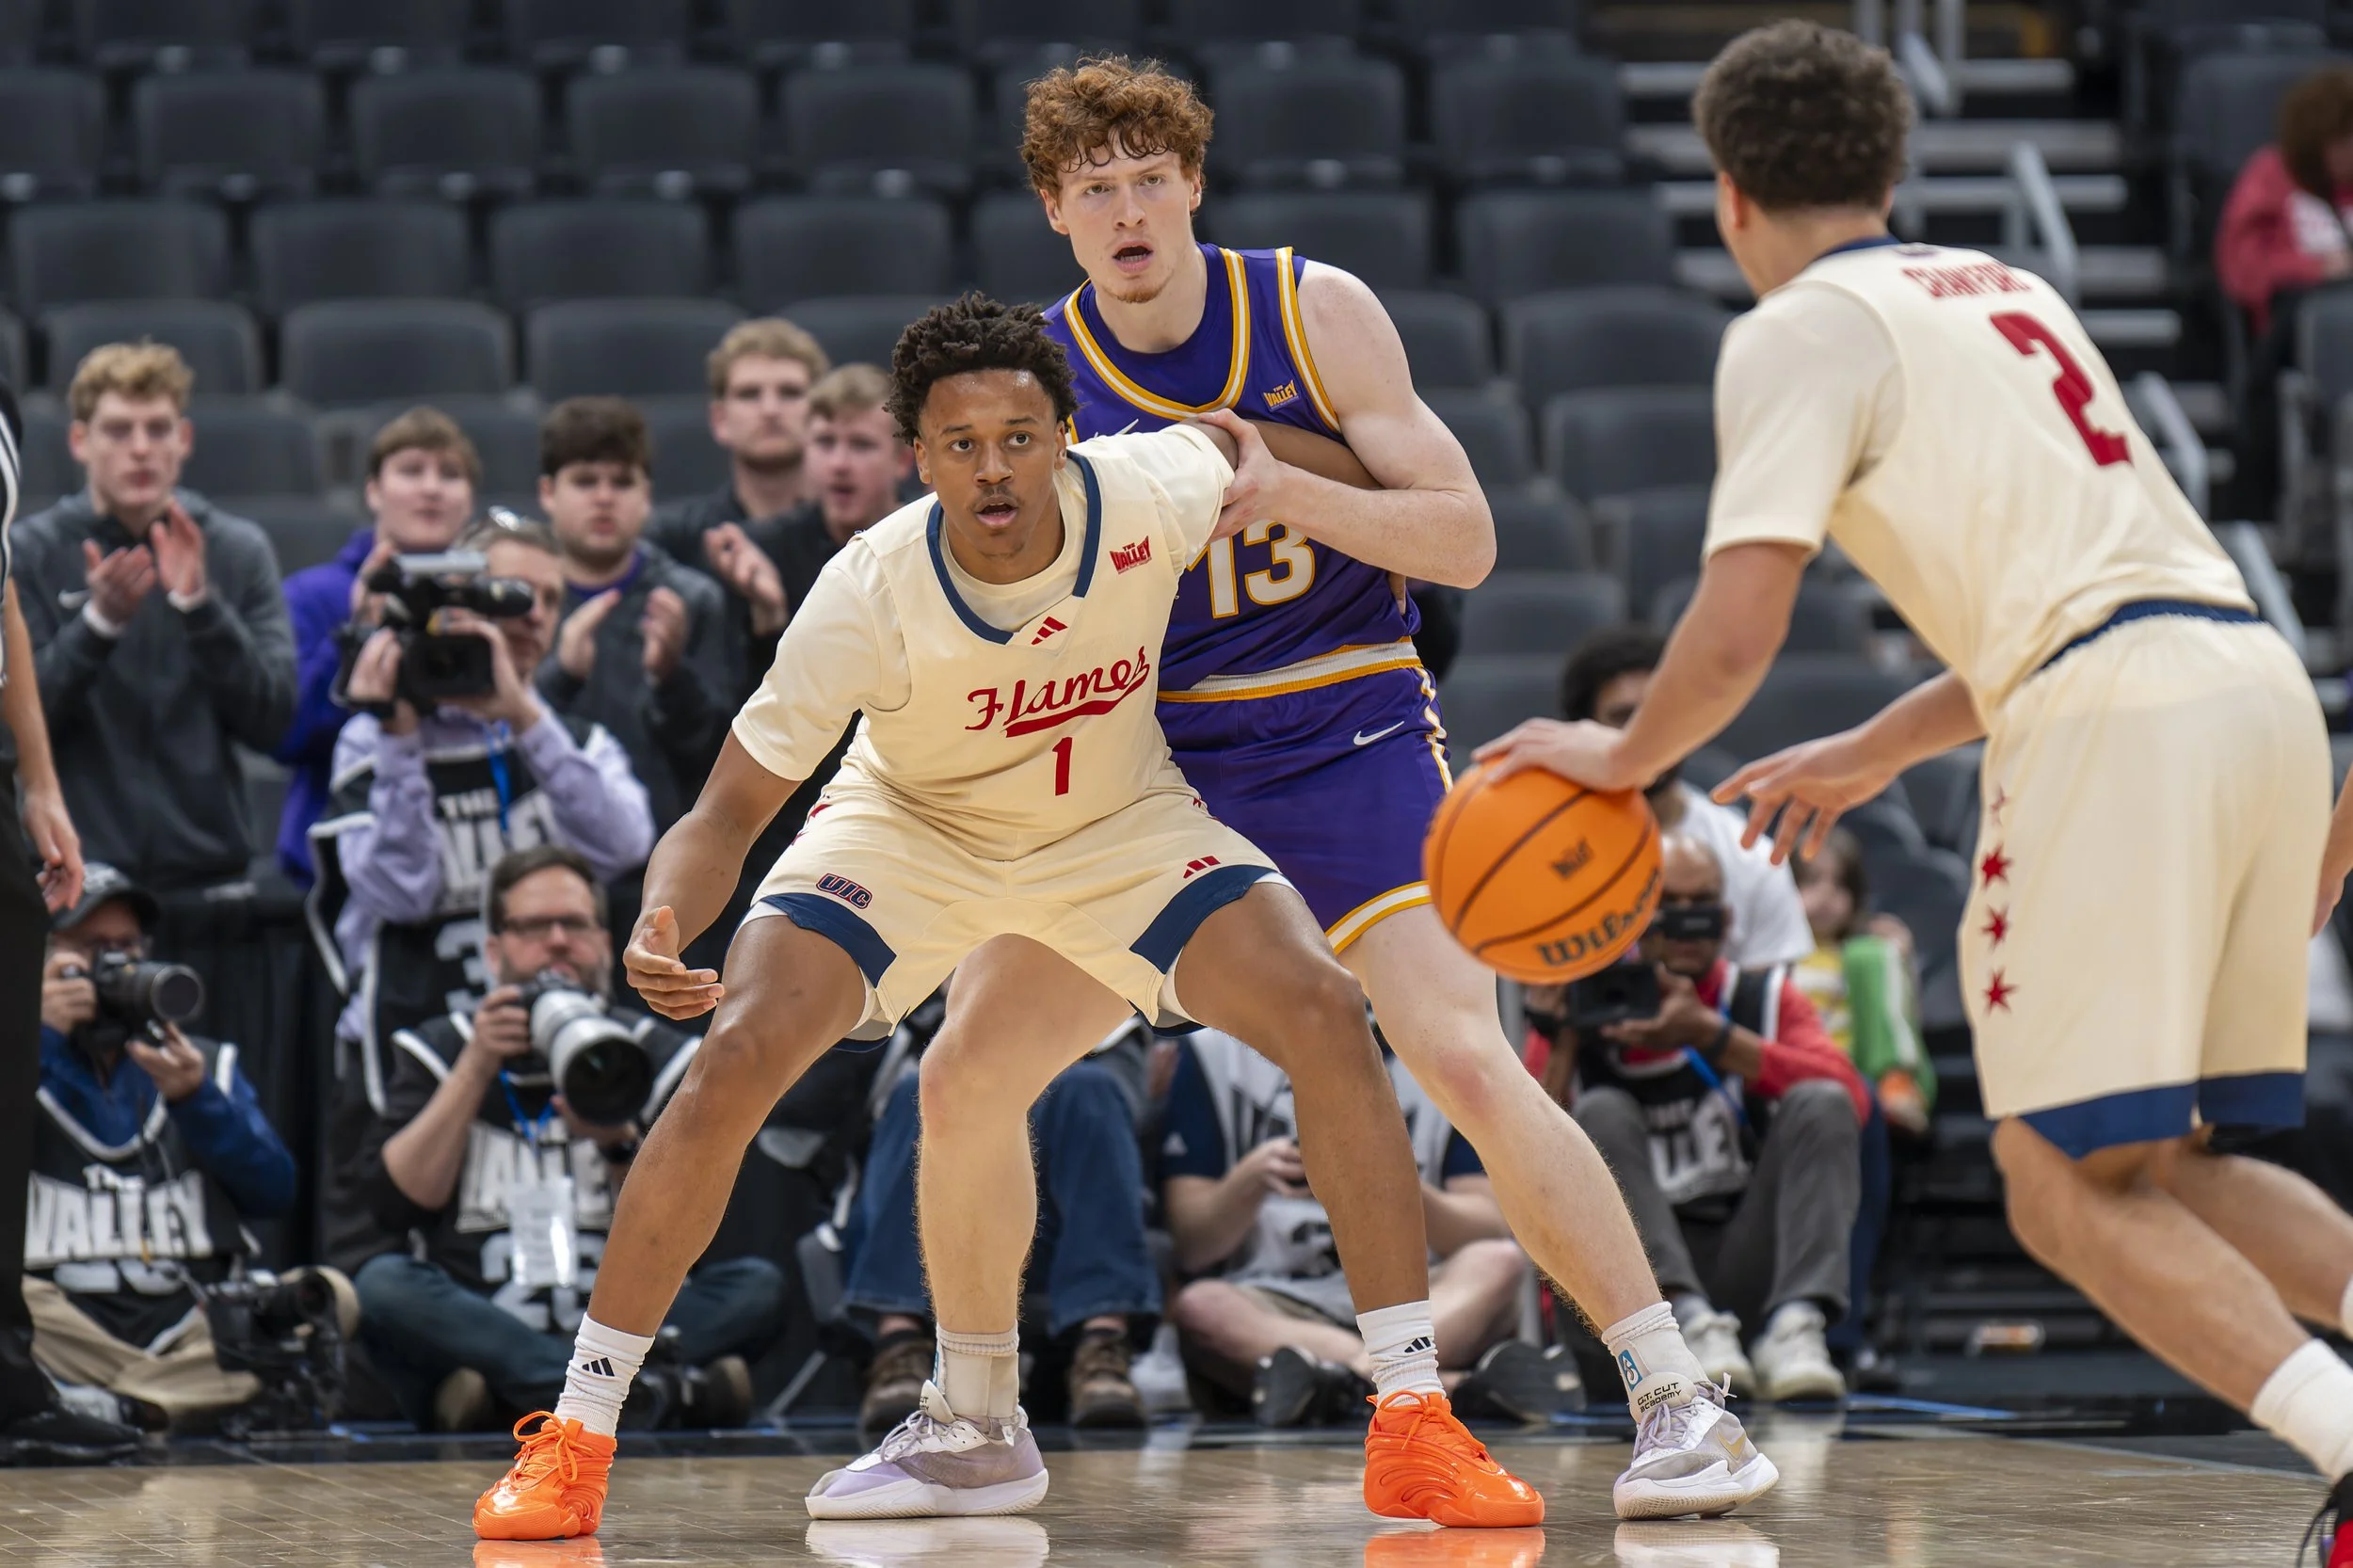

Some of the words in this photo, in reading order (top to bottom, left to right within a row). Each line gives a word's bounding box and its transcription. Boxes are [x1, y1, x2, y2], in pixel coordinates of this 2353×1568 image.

[1263, 379, 1298, 408] VALLEY
[1989, 310, 2134, 468] 2
[1109, 535, 1151, 571] VALLEY
[1185, 519, 1316, 619] 13
[965, 646, 1151, 730] Flames
[1052, 736, 1073, 796] 1
[816, 873, 872, 909] UIC
[24, 1170, 213, 1271] VALLEY
[1654, 1382, 1679, 1396] CUT
